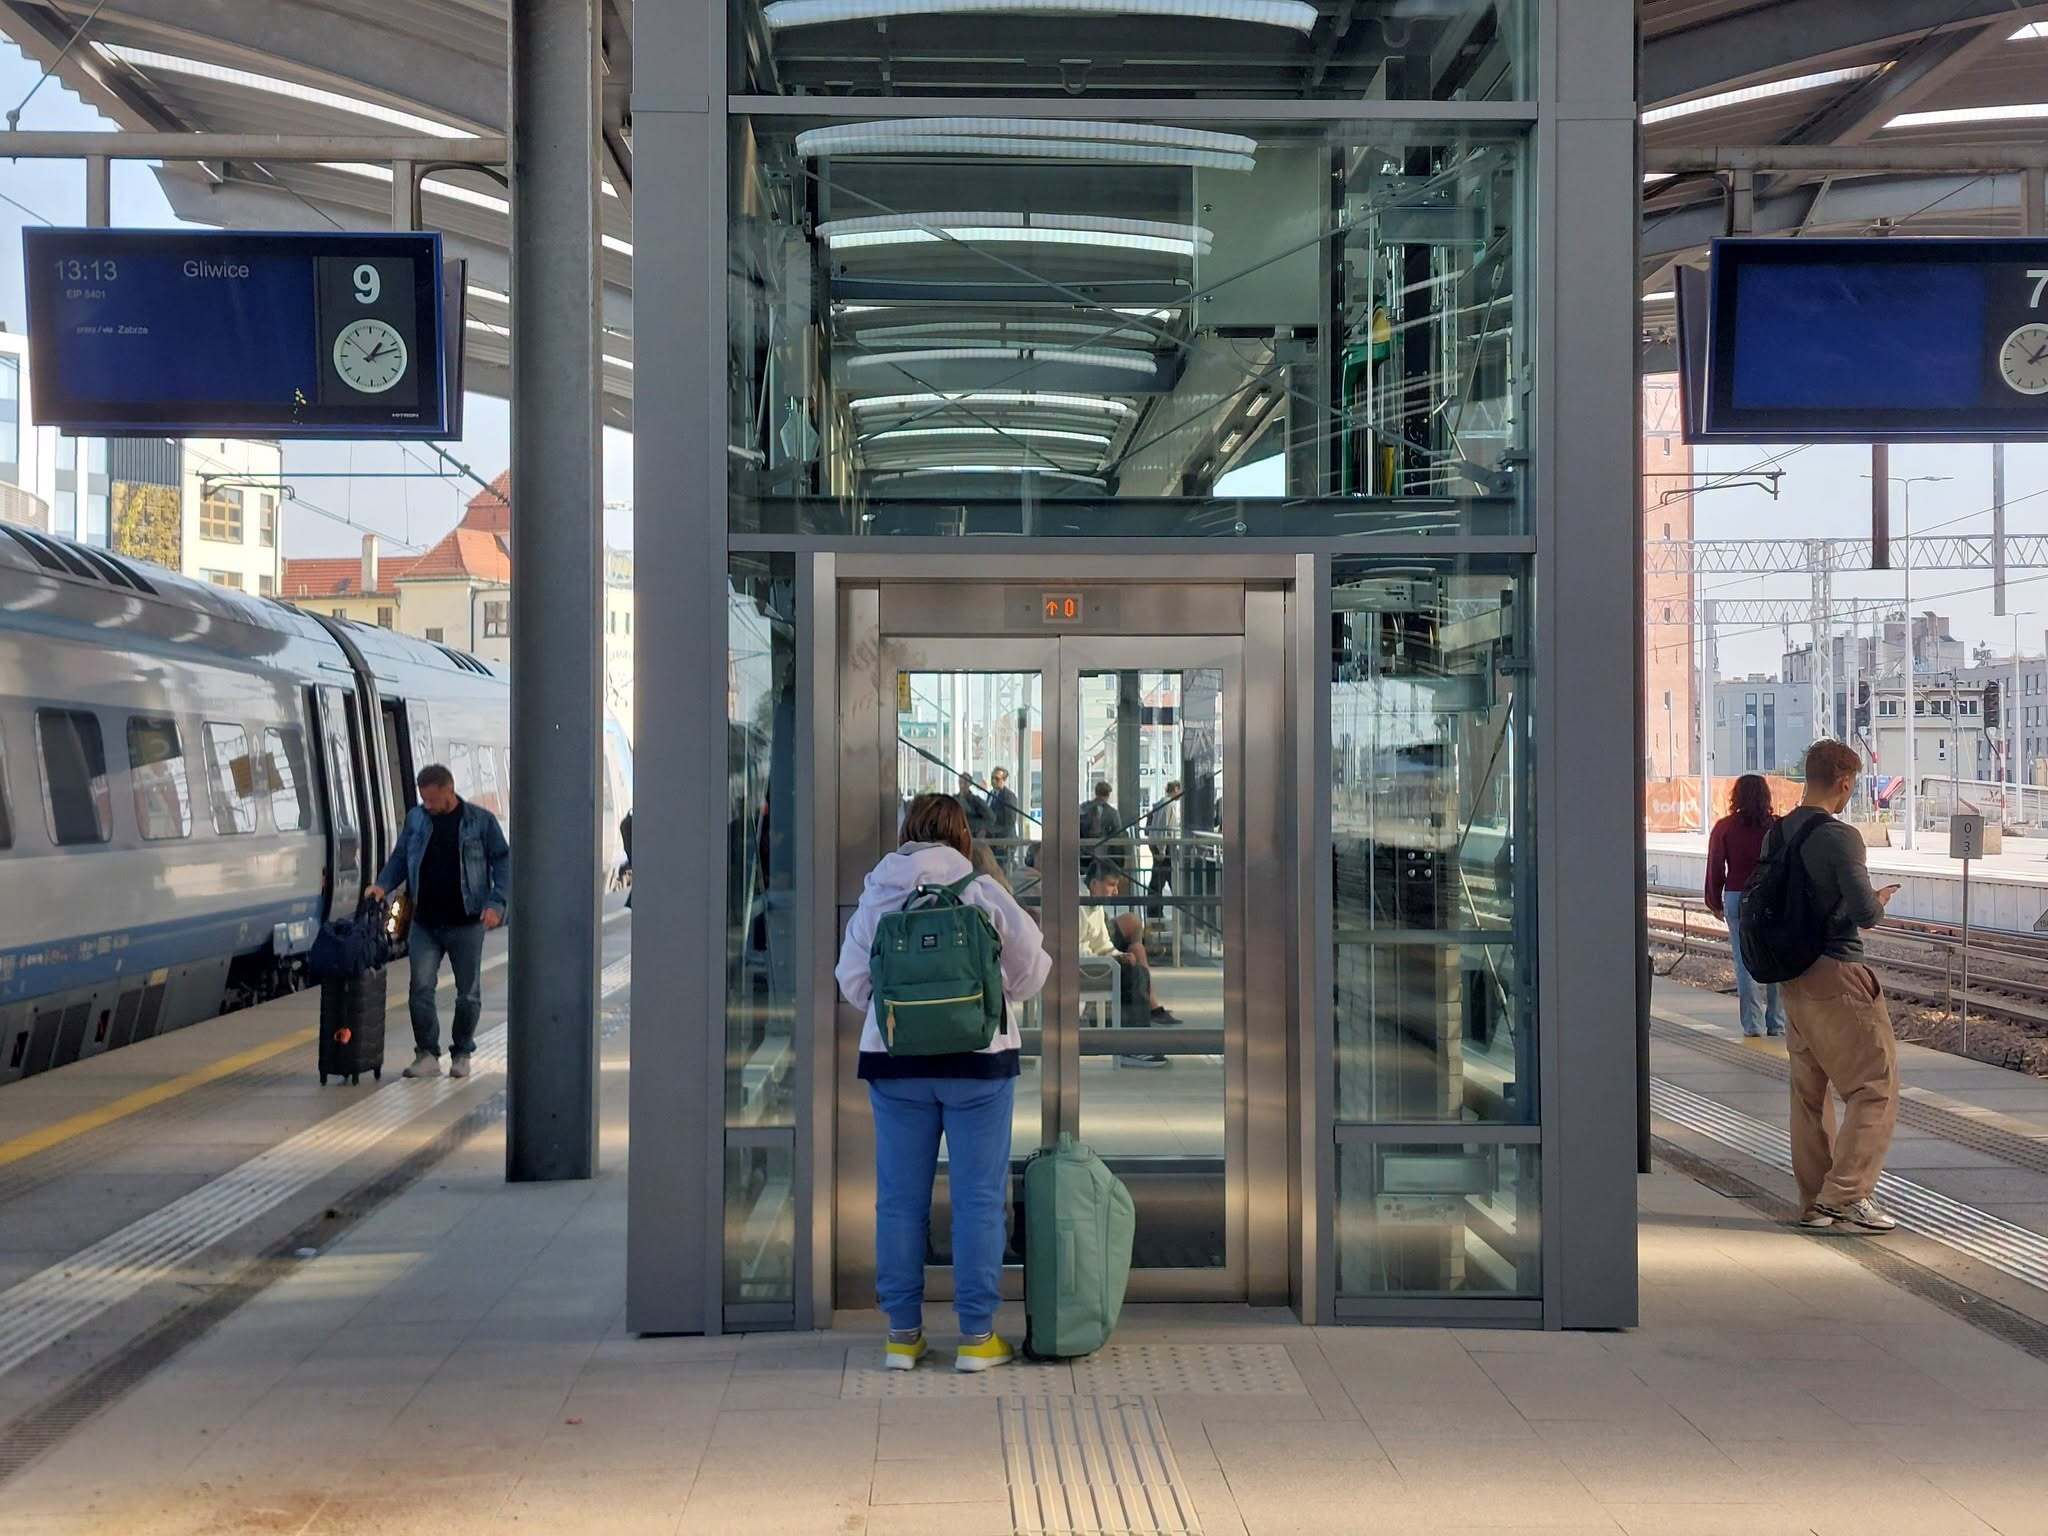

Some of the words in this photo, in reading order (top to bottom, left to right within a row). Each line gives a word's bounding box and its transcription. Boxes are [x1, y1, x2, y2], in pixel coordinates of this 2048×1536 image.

[54, 260, 118, 281] 13:13
[183, 260, 249, 278] Gliwice
[353, 264, 381, 304] 9
[2026, 269, 2048, 308] 7
[1064, 599, 1074, 617] 0
[1964, 822, 1972, 834] 0
[1963, 841, 1970, 852] 3
